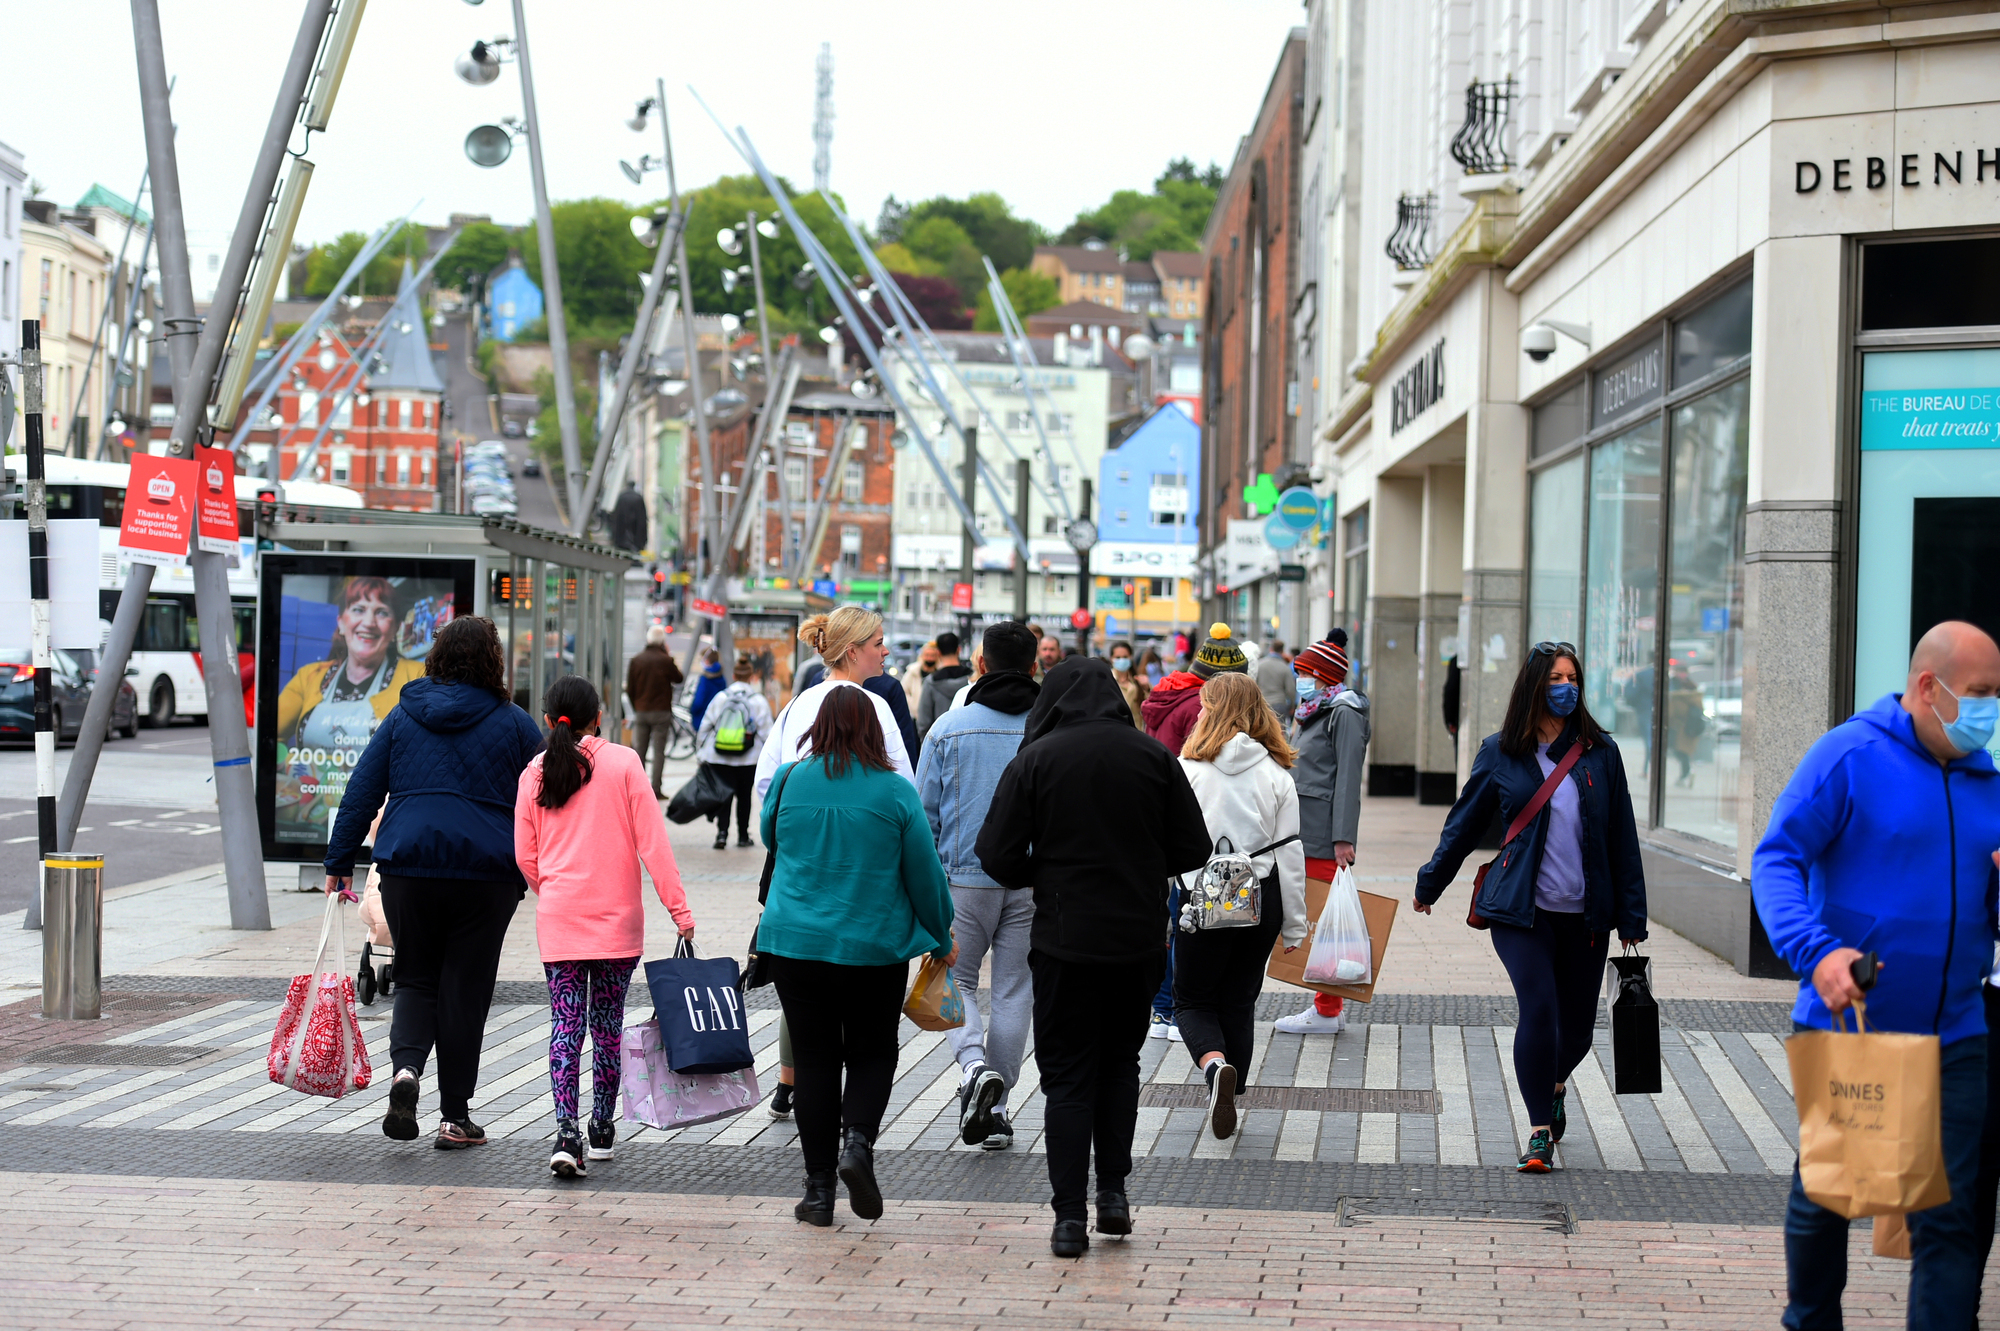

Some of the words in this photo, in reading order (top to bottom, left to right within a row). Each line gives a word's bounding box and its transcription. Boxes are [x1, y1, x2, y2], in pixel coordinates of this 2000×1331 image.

[1796, 148, 2000, 193] DEBENH
[1870, 397, 1898, 412] THE
[1903, 396, 1965, 411] BUREAU
[1970, 395, 1991, 410] DE
[1902, 417, 1939, 437] that
[1941, 421, 1991, 437] treats
[152, 483, 170, 493] OPEN
[137, 509, 165, 520] Thanks
[166, 513, 178, 522] for
[127, 525, 146, 535] local
[148, 527, 182, 540] business
[134, 519, 178, 531] supporting
[684, 986, 741, 1032] GAP
[1852, 1102, 1884, 1112] STORES
